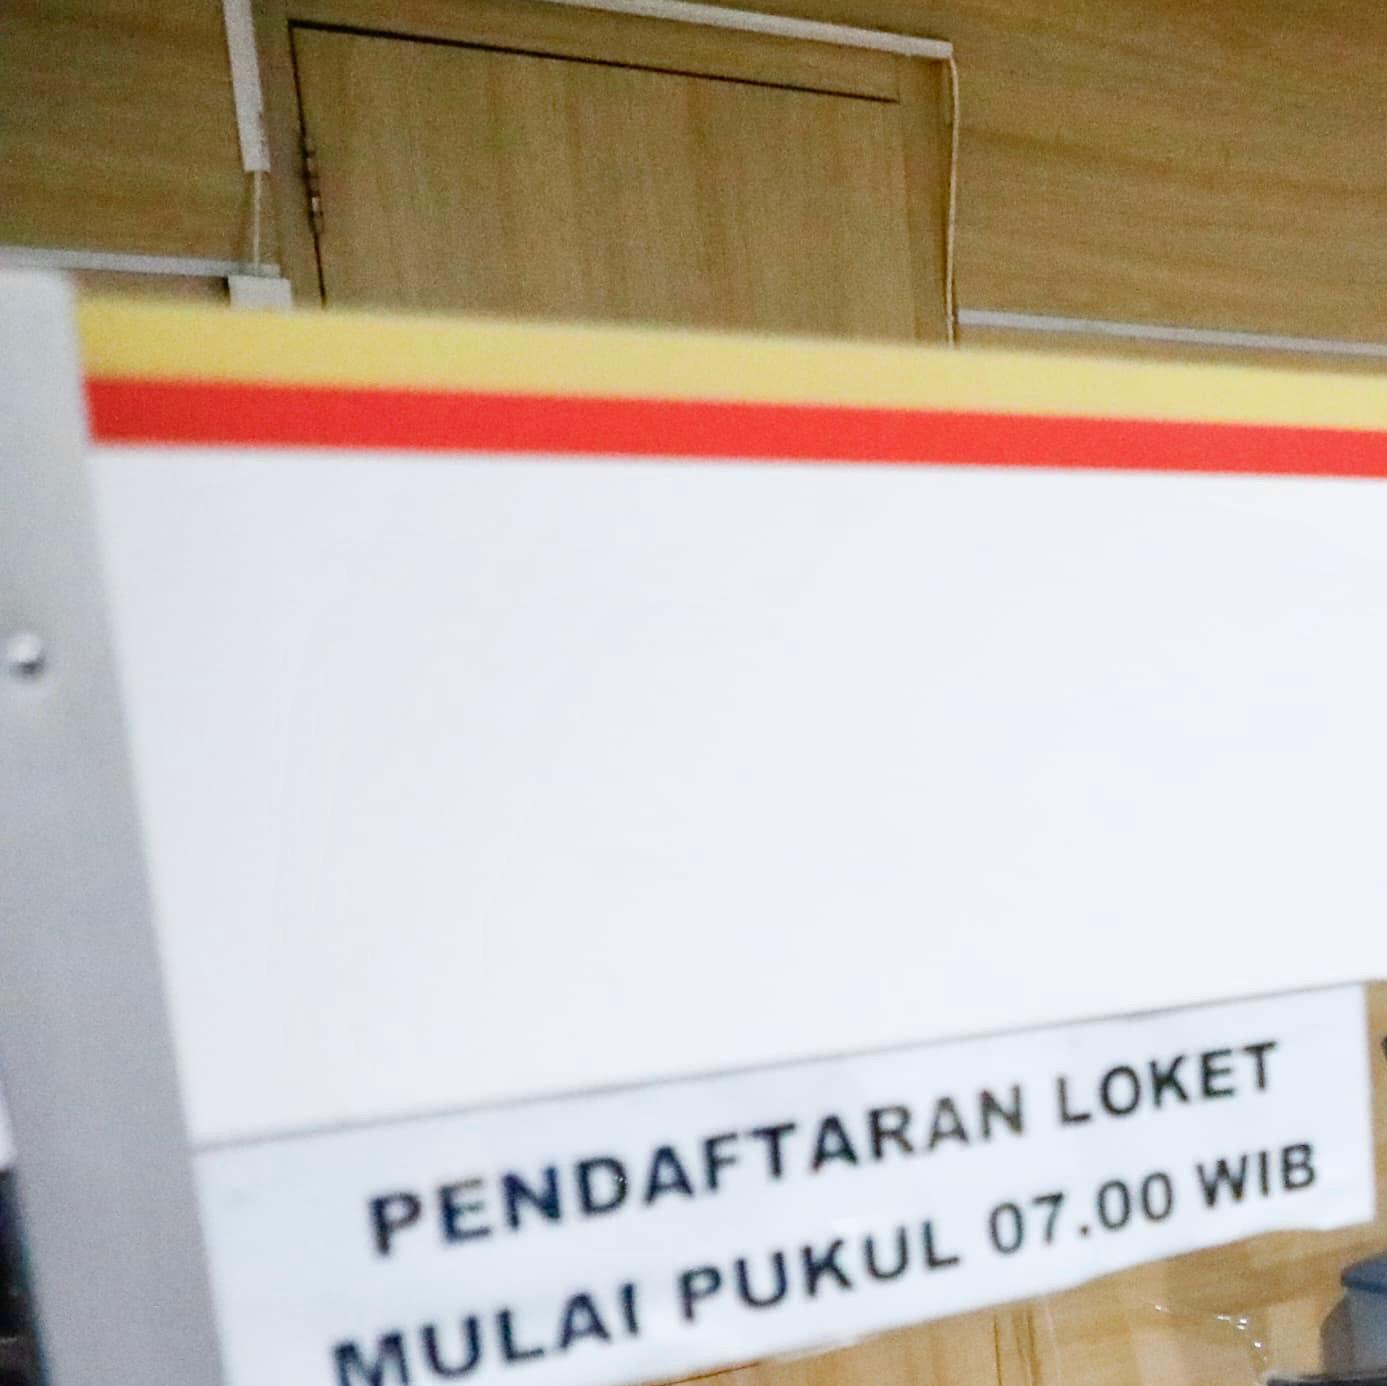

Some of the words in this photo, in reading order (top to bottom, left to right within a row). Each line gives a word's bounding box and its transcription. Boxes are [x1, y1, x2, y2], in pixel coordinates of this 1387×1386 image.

[366, 1083, 1024, 1258] PENDAFTARAN
[1055, 1041, 1277, 1126] LOKET
[677, 1219, 960, 1324] PUKUL
[988, 1171, 1174, 1256] 07.00
[1196, 1142, 1316, 1209] WIB
